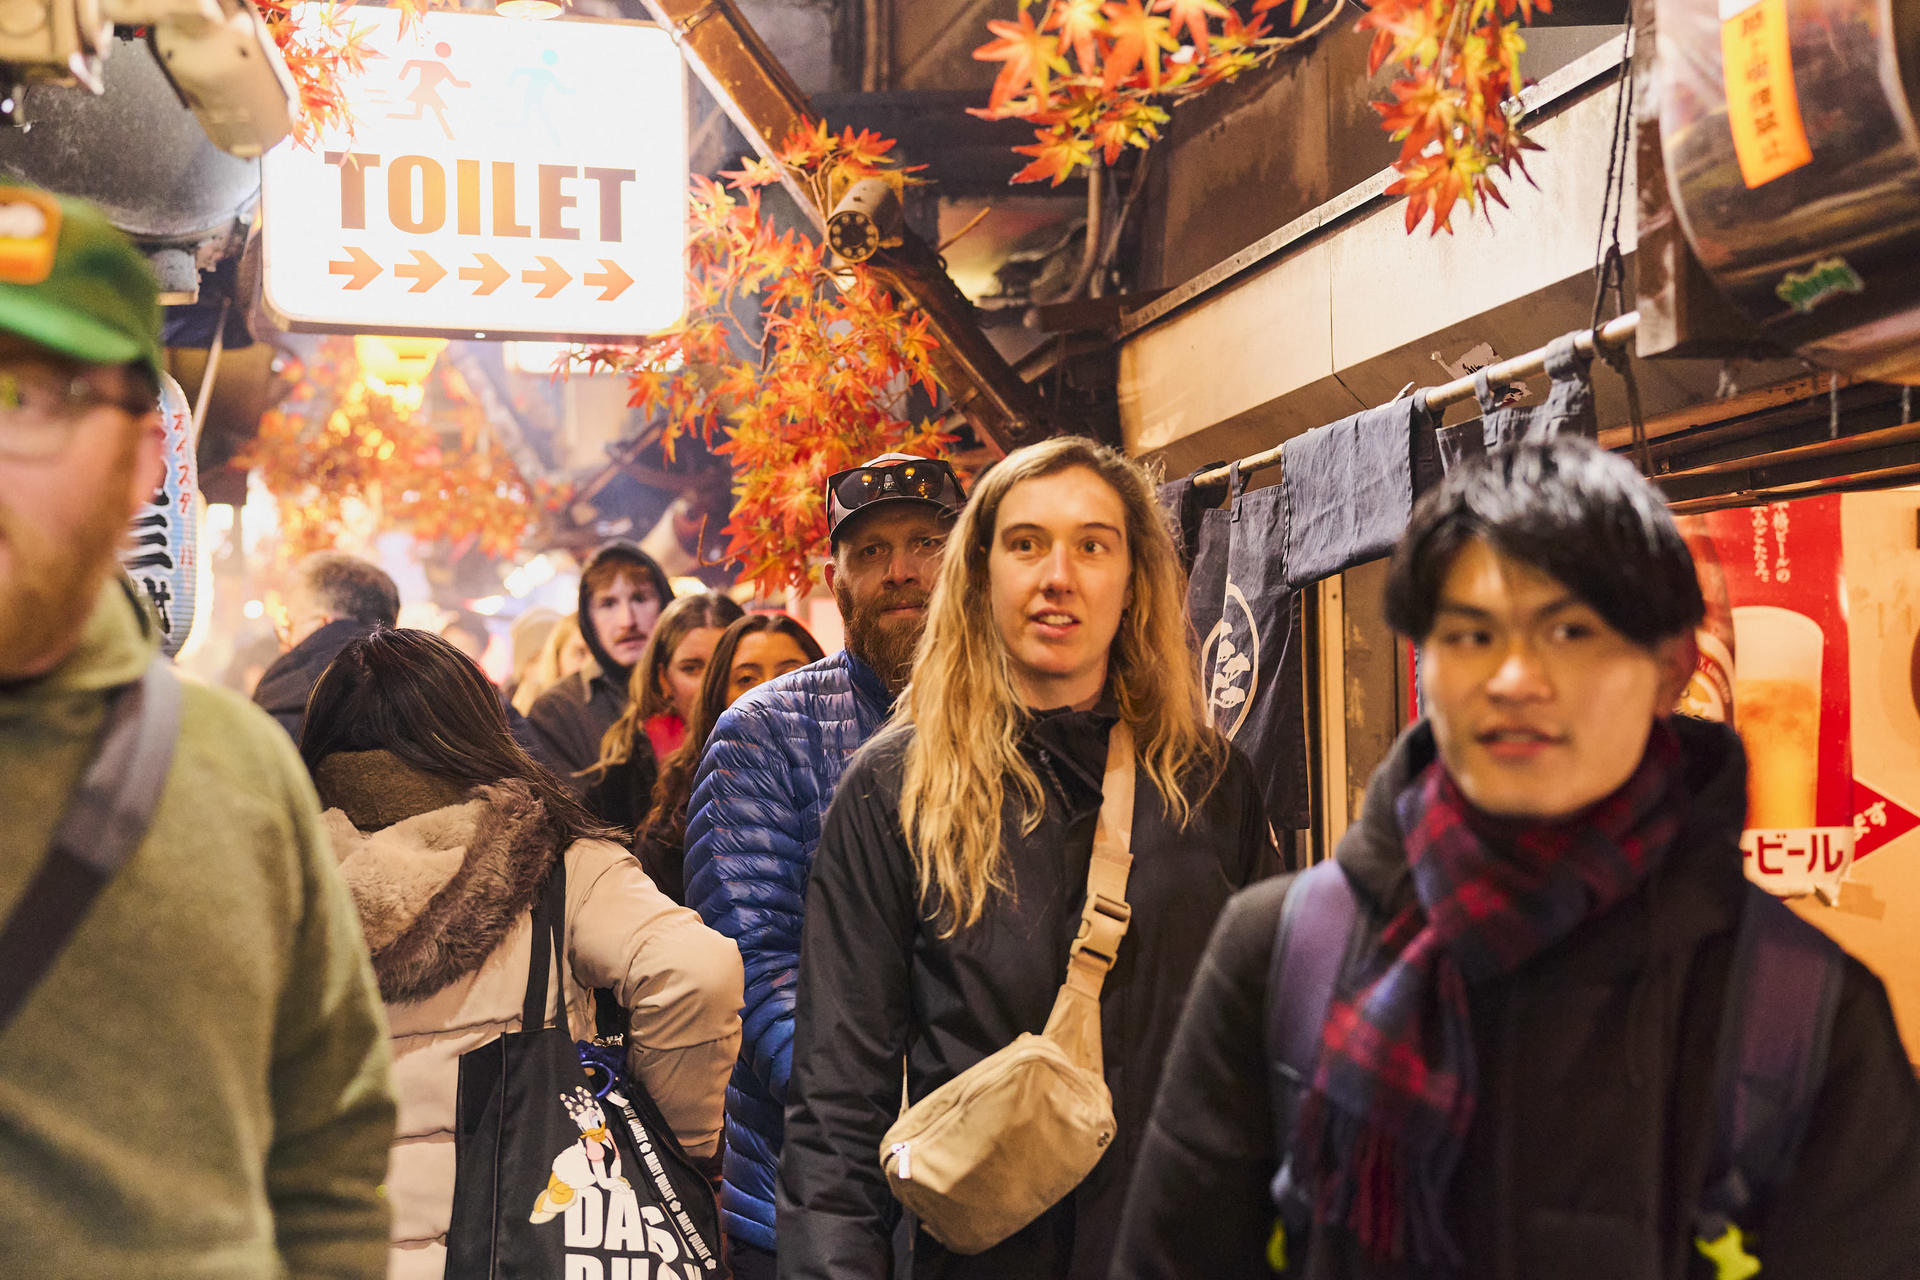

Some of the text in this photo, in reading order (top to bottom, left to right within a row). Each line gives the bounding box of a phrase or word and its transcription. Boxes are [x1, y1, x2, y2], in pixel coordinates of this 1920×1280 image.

[324, 150, 636, 243] TOILET
[643, 1151, 677, 1202] MARY QUANT
[676, 1211, 712, 1260] MARY QUANT
